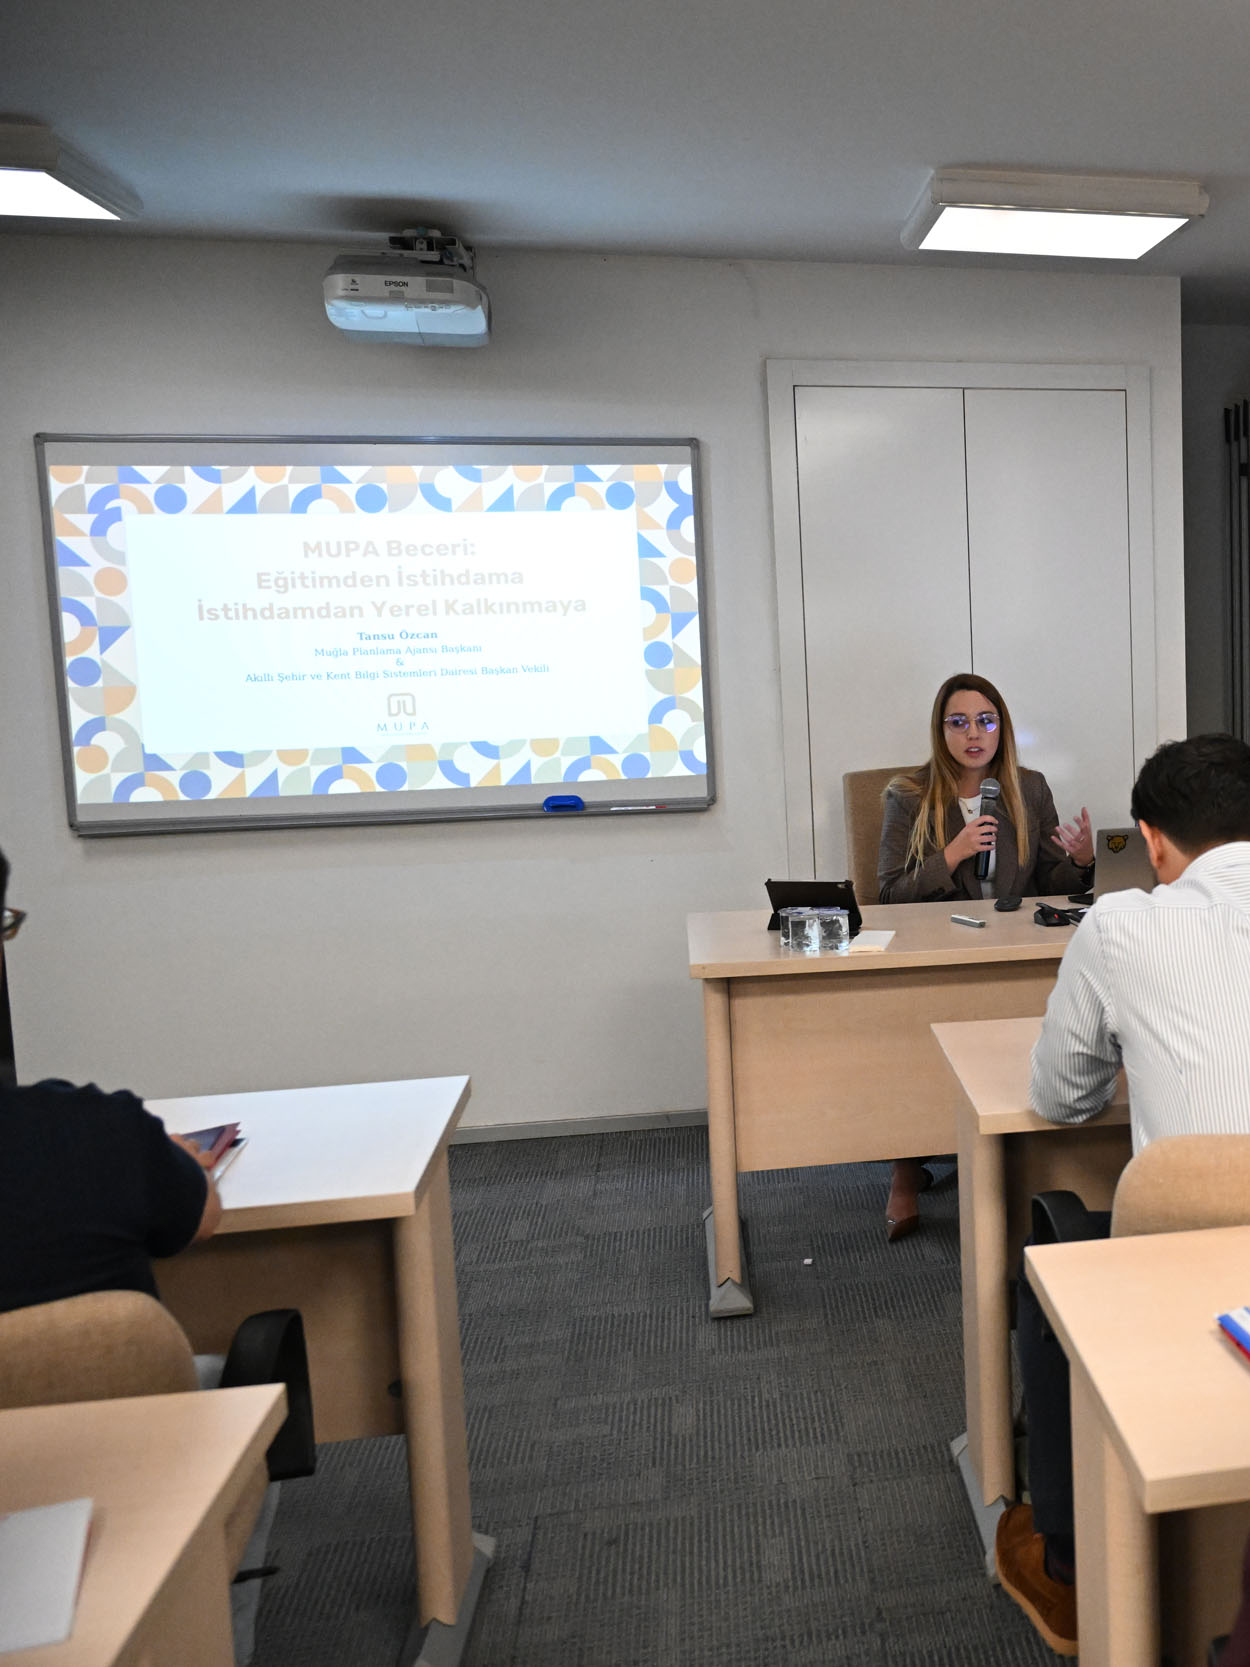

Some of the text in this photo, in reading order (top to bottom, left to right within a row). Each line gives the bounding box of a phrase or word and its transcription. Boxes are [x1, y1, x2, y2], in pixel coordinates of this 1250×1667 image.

[384, 280, 409, 288] EPSON
[303, 538, 476, 559] MUPA Beceri:
[256, 565, 524, 594] Eğitimden İstihdama
[197, 598, 587, 621] İstihdamdan Yerel Kalkınmaya
[357, 629, 438, 641] Tansu Özcan
[314, 644, 482, 659] Muğla Planlama Ajansı Başkanı
[245, 664, 550, 683] Akıllı Şehir ve Kent Bilgi Sistemleri Dairesi Başkan Vekili
[377, 721, 430, 732] MUPA
